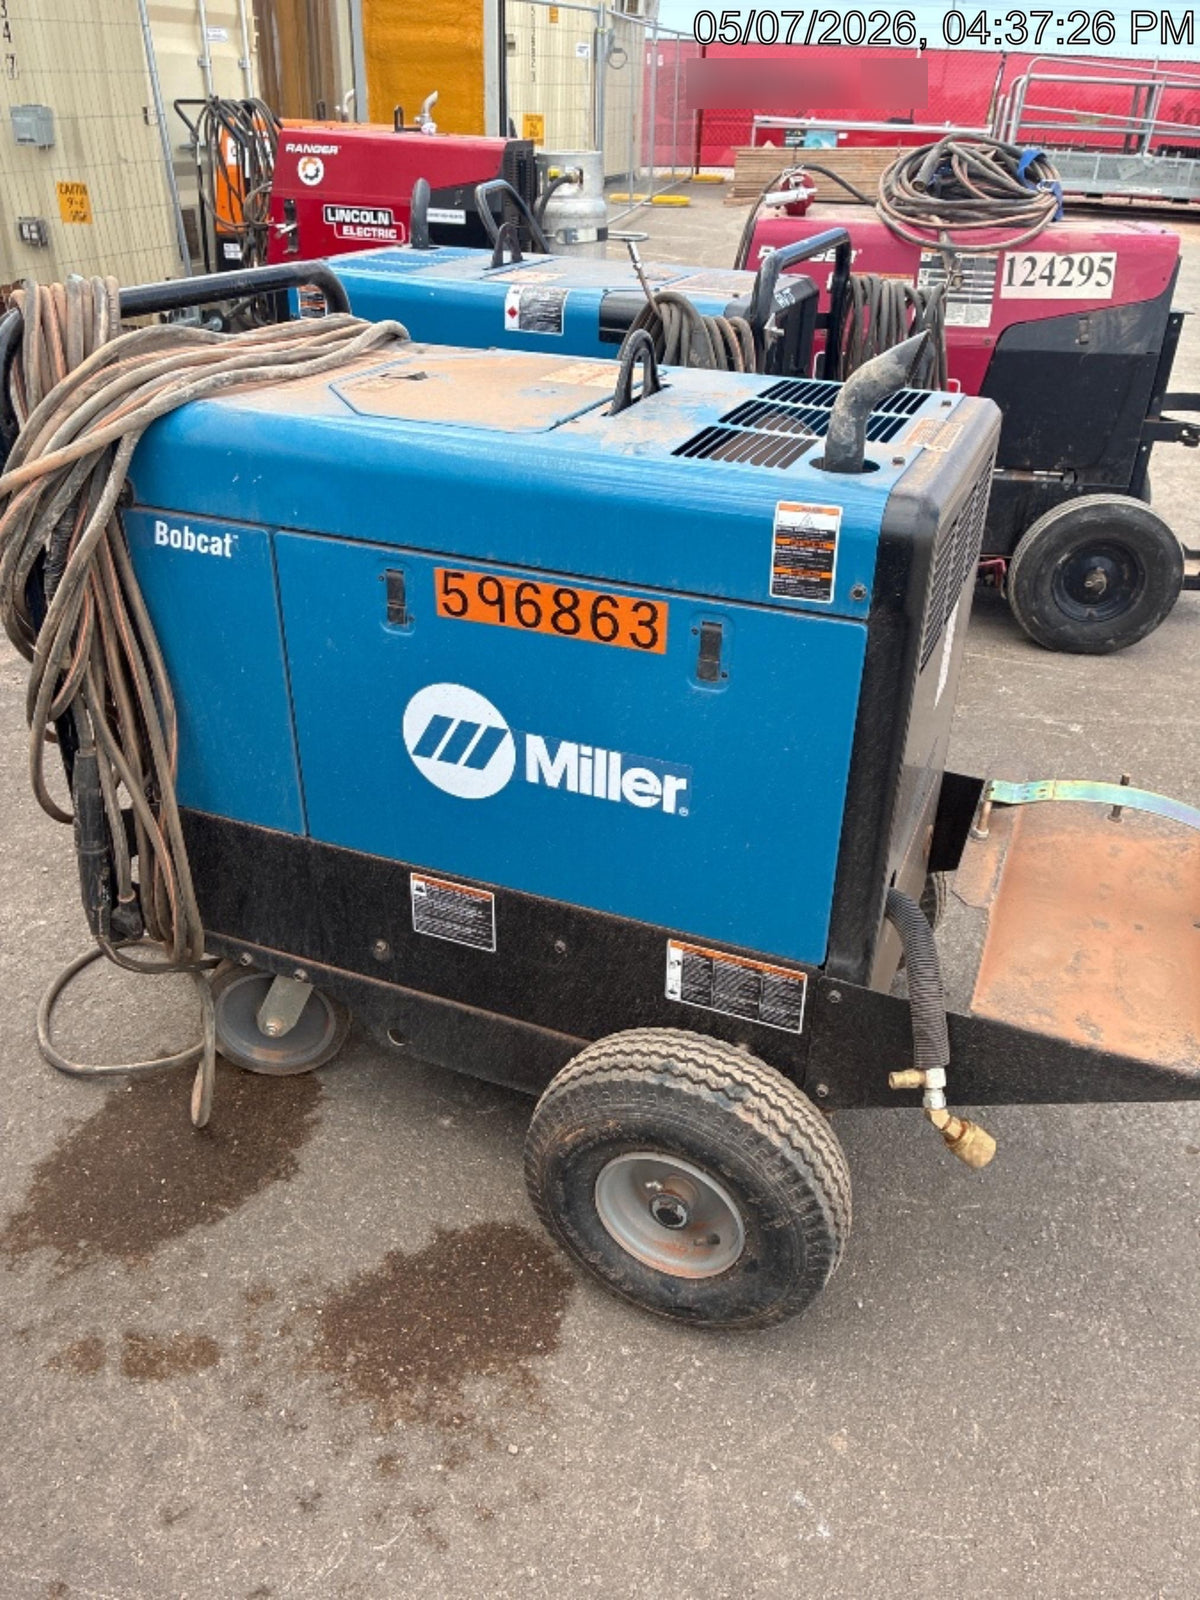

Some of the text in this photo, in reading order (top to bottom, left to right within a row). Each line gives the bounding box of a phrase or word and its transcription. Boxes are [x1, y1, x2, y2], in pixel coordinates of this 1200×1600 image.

[285, 143, 338, 155] RANGER
[326, 207, 390, 226] LINCOLN
[342, 225, 397, 240] ELECTRIC
[1003, 255, 1114, 288] 124295
[154, 520, 233, 558] Bobcat
[442, 570, 659, 650] 596863
[525, 733, 688, 815] Miller
